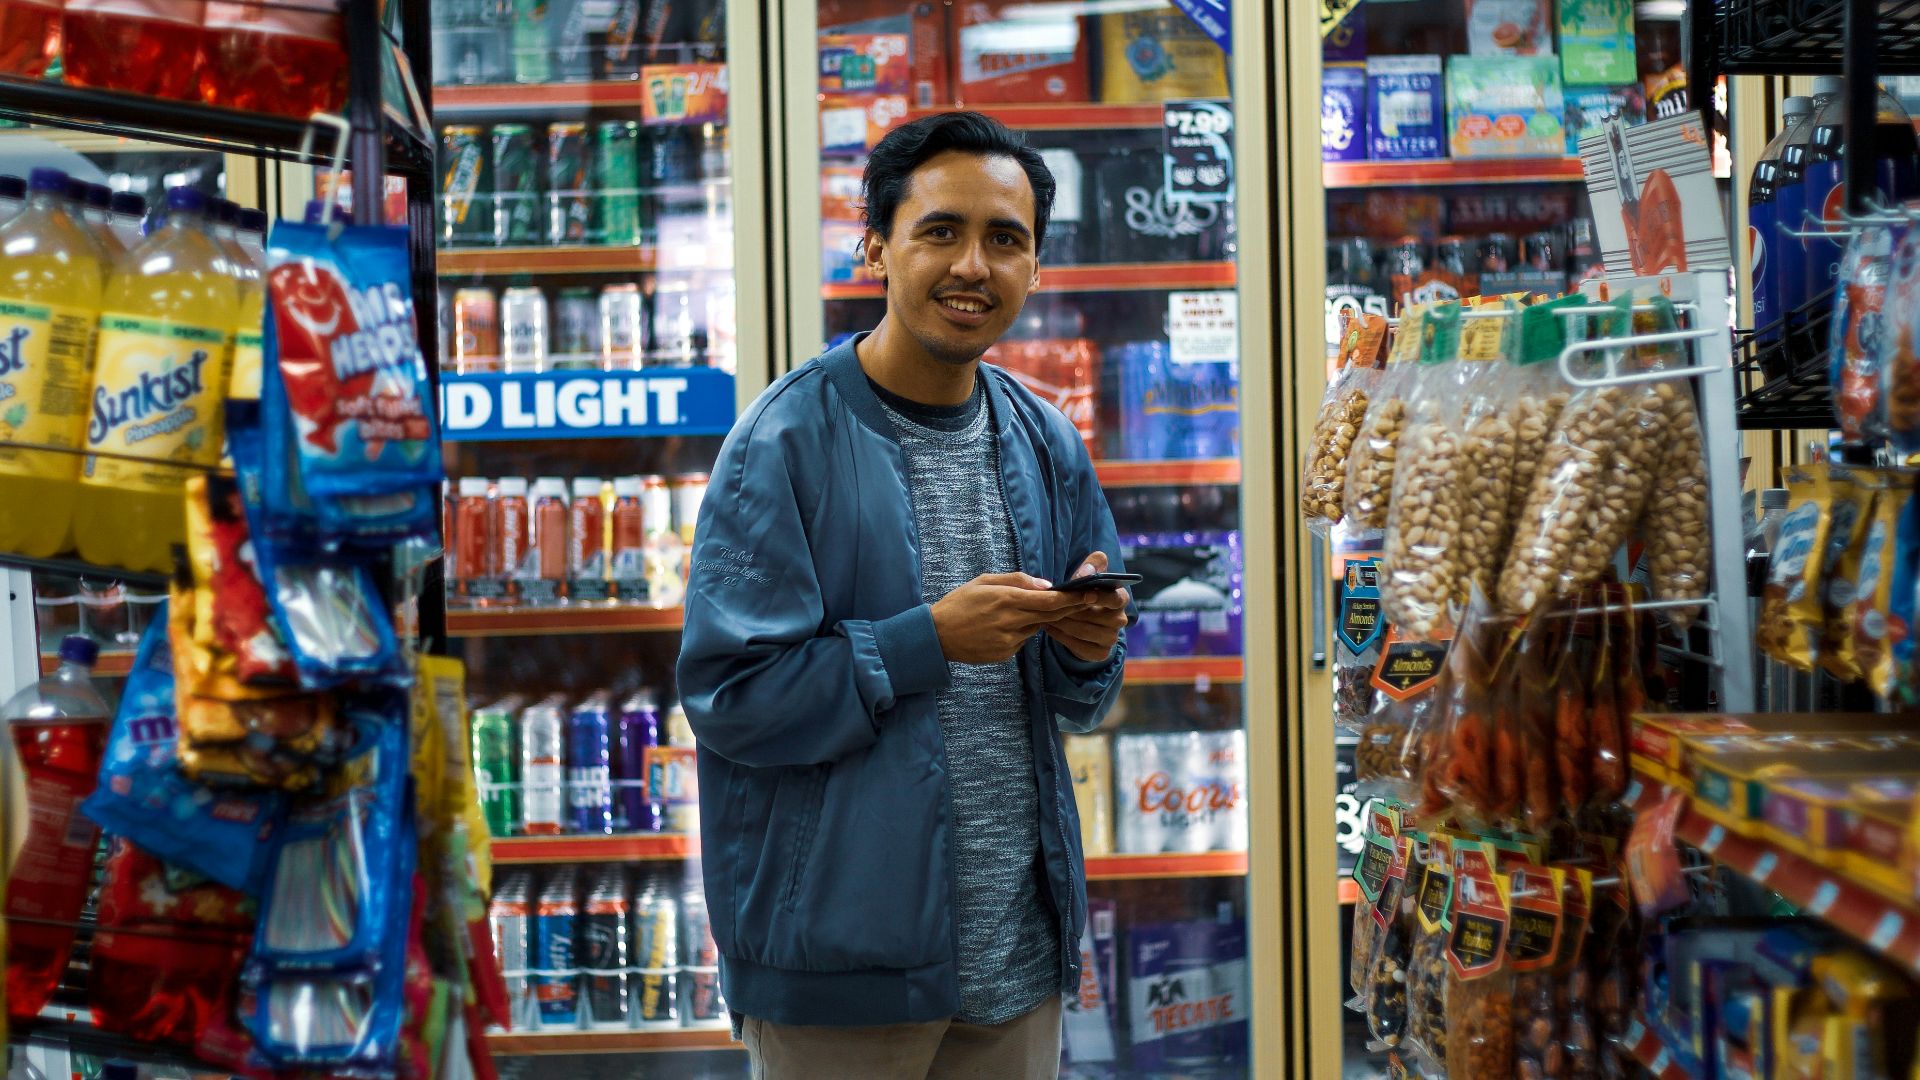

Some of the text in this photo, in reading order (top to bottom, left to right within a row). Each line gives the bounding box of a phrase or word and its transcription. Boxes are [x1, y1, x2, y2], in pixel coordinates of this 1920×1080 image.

[1374, 137, 1438, 154] SELTZER
[88, 350, 208, 445] Sunkist
[500, 377, 688, 429] LIGHT
[124, 405, 197, 446] Pineapple
[1349, 612, 1375, 625] Almonds
[1391, 657, 1434, 673] Almonds
[1136, 769, 1241, 814] Coors
[1152, 994, 1235, 1033] TECATE
